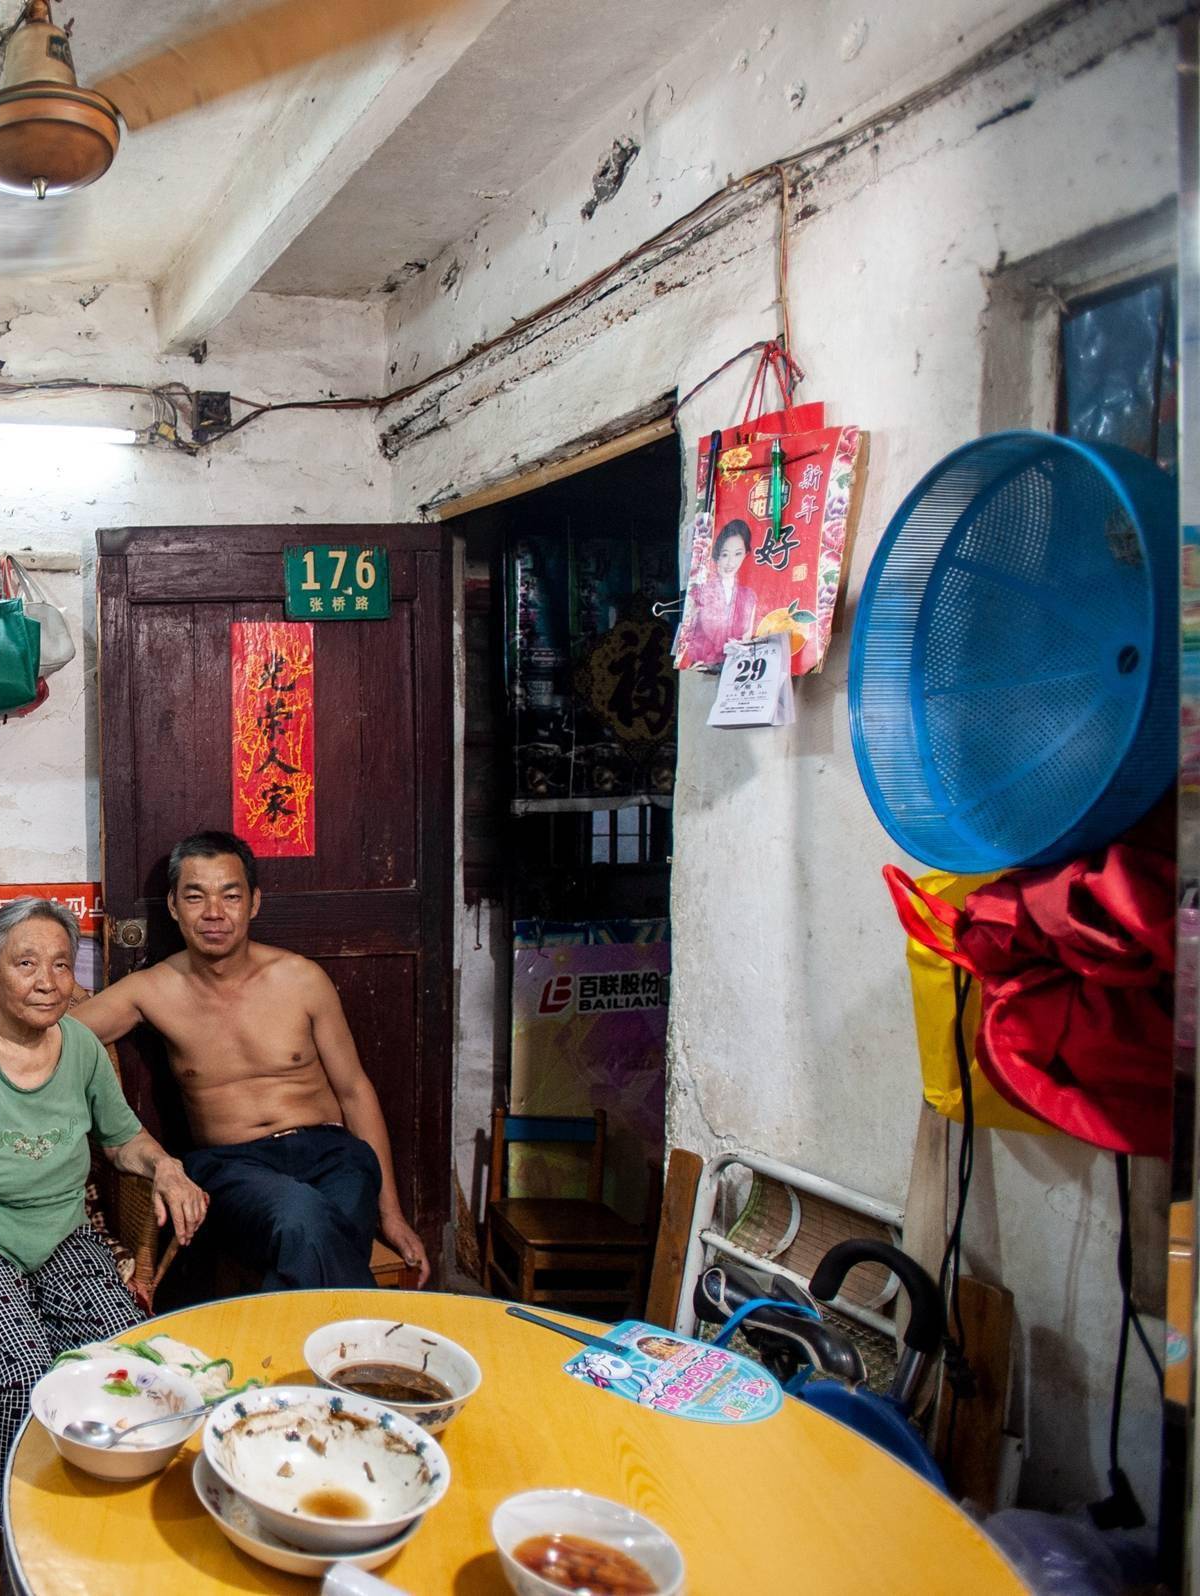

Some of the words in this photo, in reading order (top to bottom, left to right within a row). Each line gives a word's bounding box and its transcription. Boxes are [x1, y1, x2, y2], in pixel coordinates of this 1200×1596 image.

[795, 463, 823, 525] 新年
[754, 524, 800, 571] 好
[301, 550, 376, 590] 176
[309, 596, 369, 612] 张桥路
[734, 658, 767, 683] 29
[256, 653, 302, 824] 光荣人家
[578, 972, 661, 999] 百联股份
[578, 996, 659, 1011] BAILIAN
